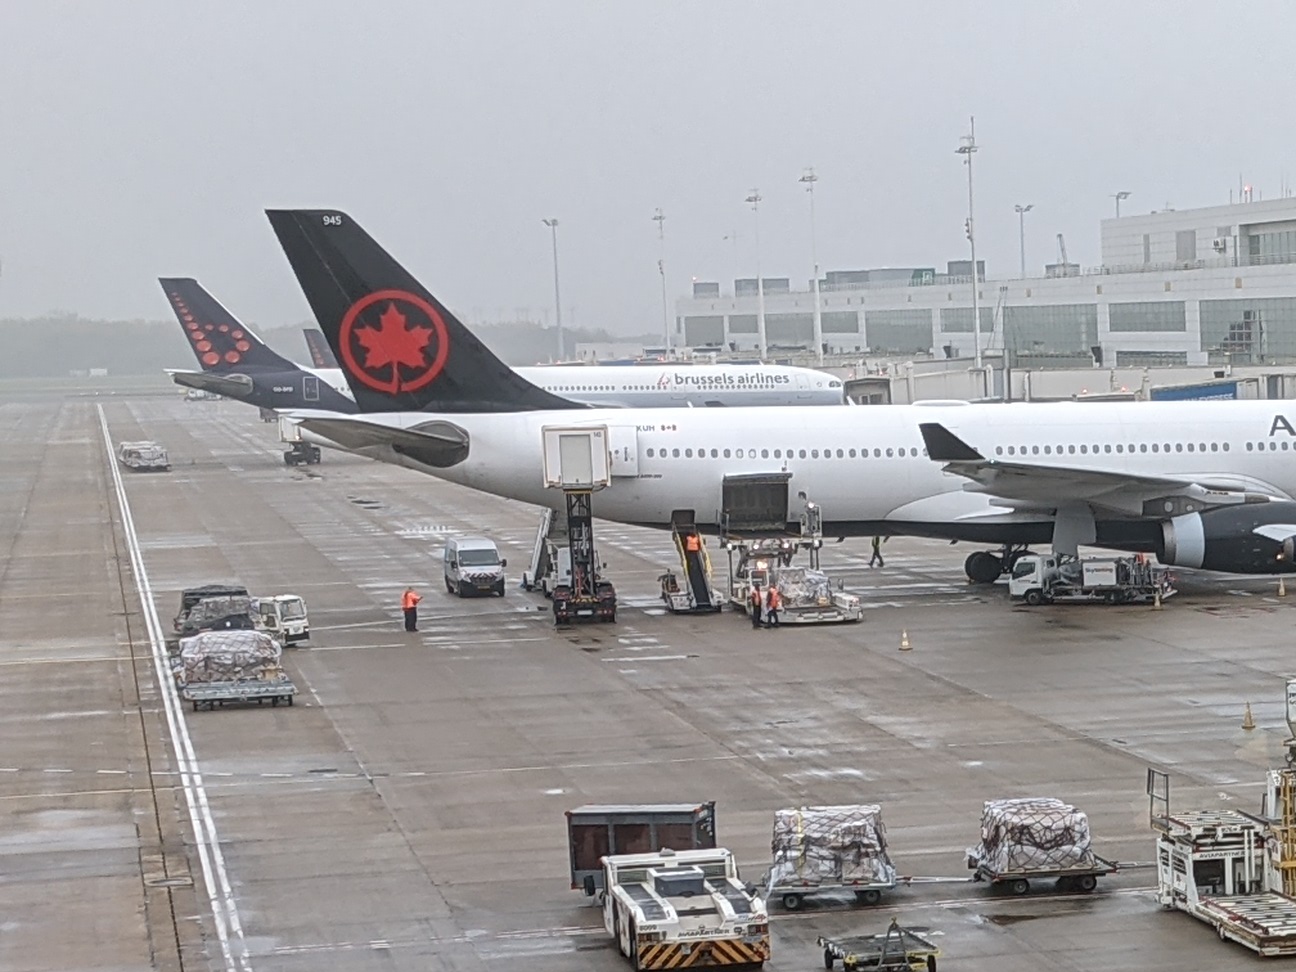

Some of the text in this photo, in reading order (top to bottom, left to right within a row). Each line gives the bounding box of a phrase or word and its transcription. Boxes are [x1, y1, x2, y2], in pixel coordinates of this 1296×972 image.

[323, 215, 342, 226] 945
[674, 373, 790, 384] brussels airlines
